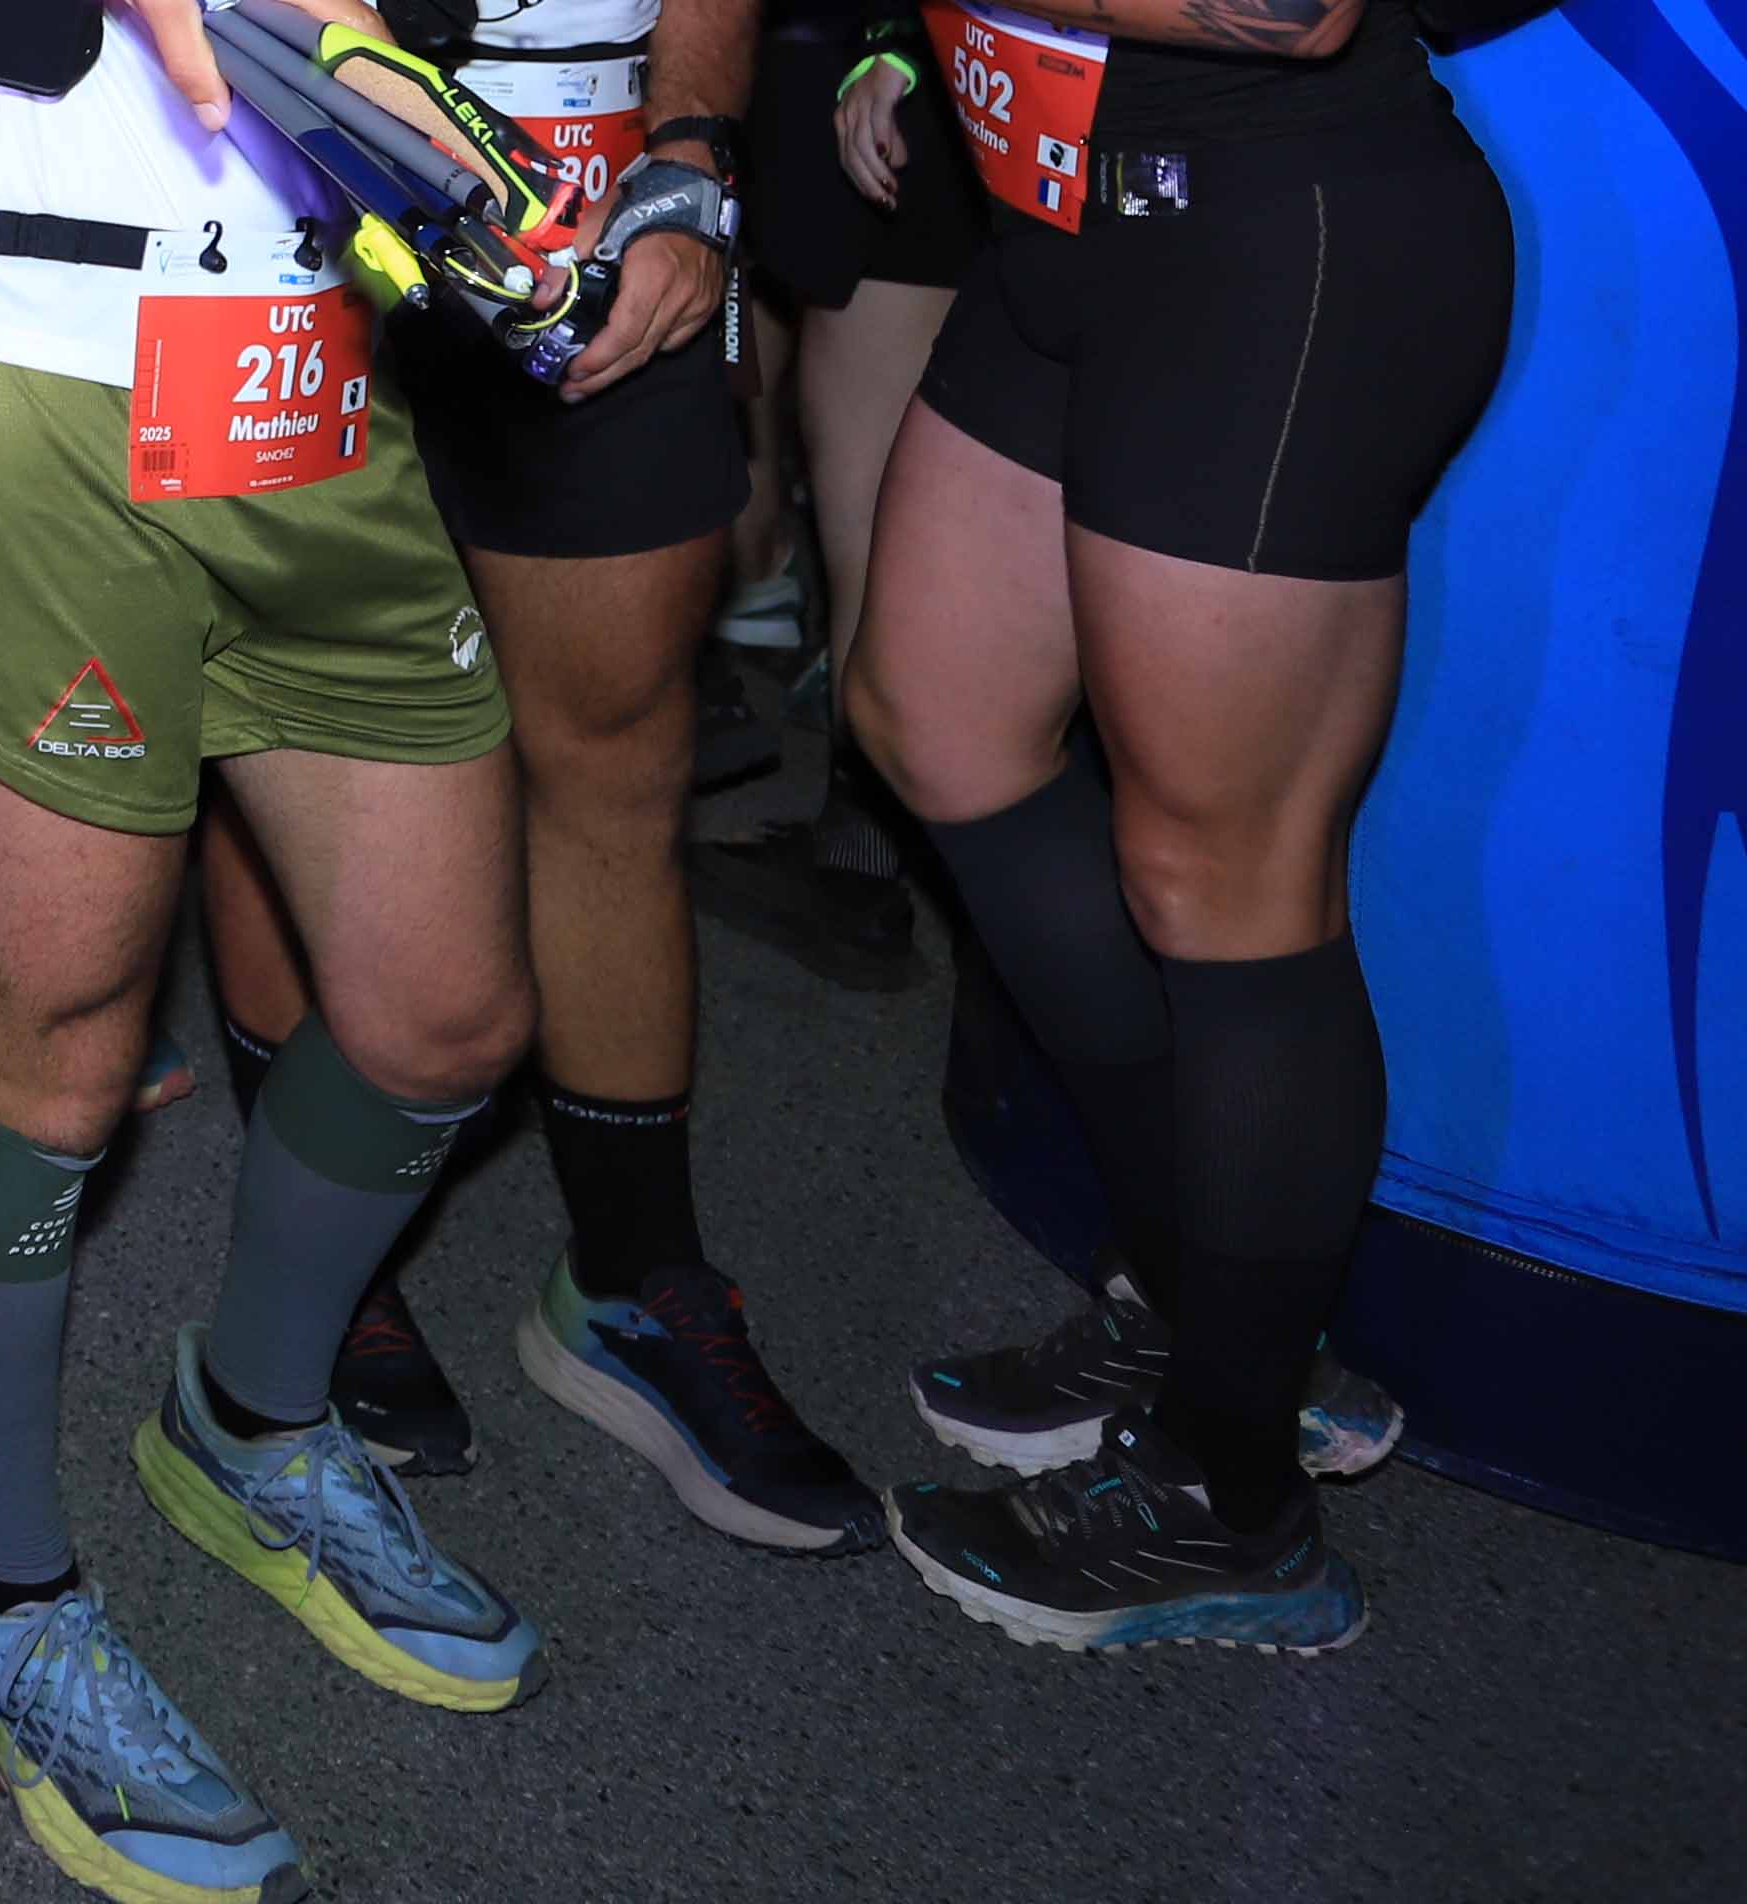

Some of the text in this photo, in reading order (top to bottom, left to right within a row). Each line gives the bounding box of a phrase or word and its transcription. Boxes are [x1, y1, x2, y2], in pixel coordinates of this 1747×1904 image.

[965, 21, 995, 57] UTC
[954, 45, 1015, 124] 502
[442, 88, 494, 144] LEKI
[554, 123, 594, 148] UTC
[633, 192, 691, 218] LEKI
[269, 303, 316, 333] UTC
[232, 338, 325, 403] 216
[139, 425, 172, 442] 2025
[228, 410, 319, 442] Mathieu
[255, 446, 296, 464] SANCHEZ
[38, 739, 100, 757] DELTA
